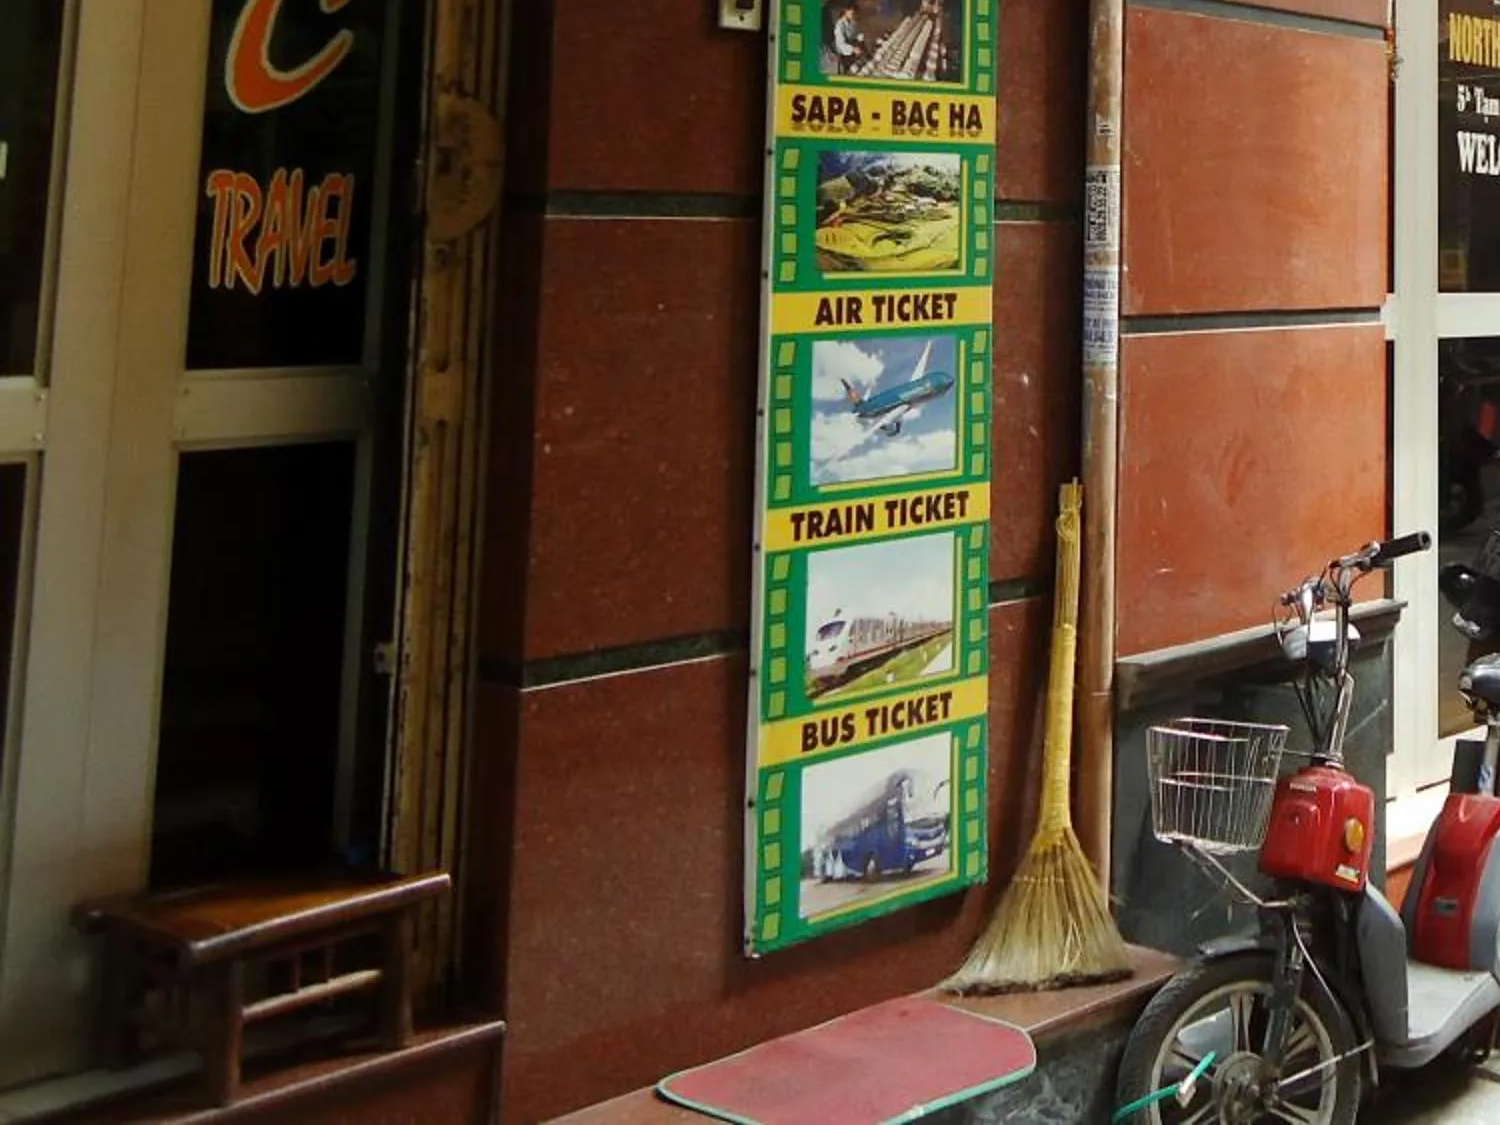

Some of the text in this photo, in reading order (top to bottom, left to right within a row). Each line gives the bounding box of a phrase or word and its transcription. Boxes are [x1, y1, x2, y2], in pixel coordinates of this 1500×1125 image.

[1449, 12, 1500, 66] NORTH
[791, 94, 983, 131] SAPA BAC HA
[207, 168, 357, 294] TRAVEL
[814, 292, 958, 326] AIR TICKET
[791, 490, 970, 542] TRAIN TICKET
[801, 690, 953, 753] BUS TICKET
